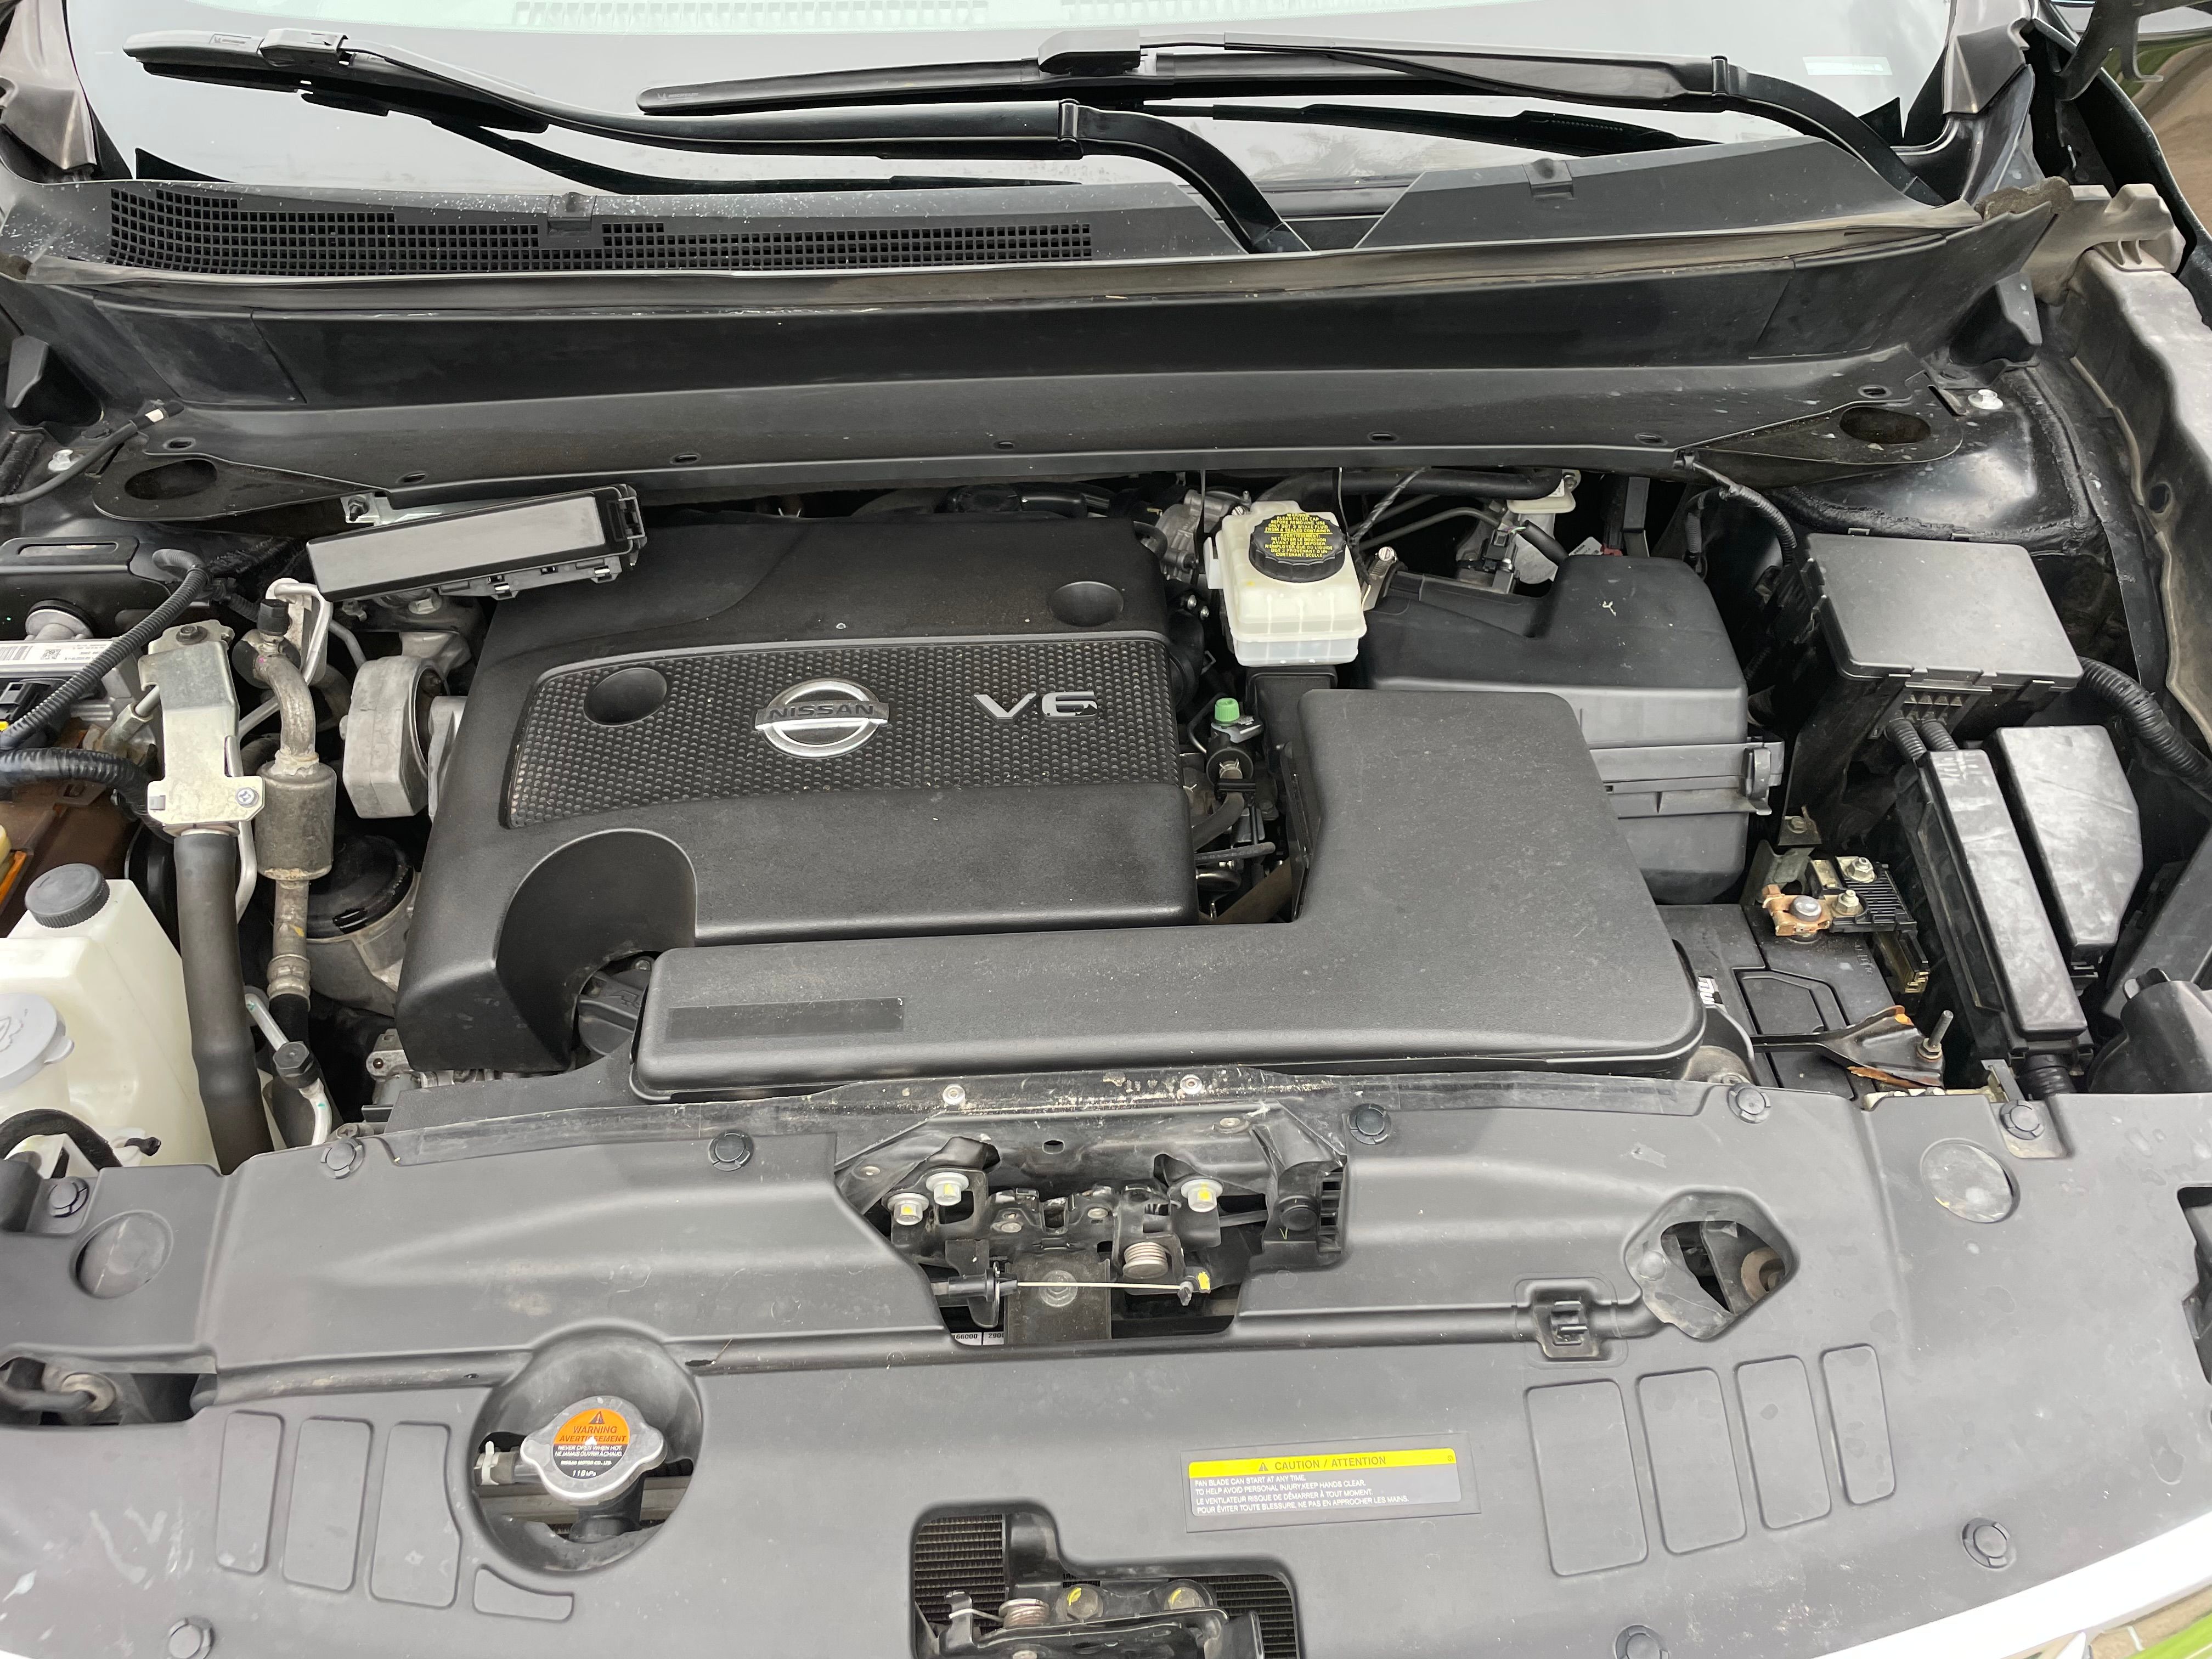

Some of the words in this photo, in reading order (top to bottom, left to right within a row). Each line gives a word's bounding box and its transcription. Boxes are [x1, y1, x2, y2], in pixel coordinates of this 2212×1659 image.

[768, 703, 874, 720] NISSAN
[972, 690, 1098, 722] V6
[1274, 1459, 1319, 1470] CAUTION
[1331, 1456, 1386, 1467] ATTENTION
[1205, 1496, 1246, 1504] VENTILATEUR
[1248, 1494, 1272, 1502] RISQUE
[1283, 1492, 1319, 1500] DÉMARRER
[1320, 1489, 1324, 1498] À
[1344, 1488, 1373, 1497] MOMENT.
[1244, 1485, 1279, 1493] PERSONAL
[1217, 1504, 1239, 1513] ÉVITER
[1261, 1502, 1297, 1510] BLESSURE,
[1333, 1497, 1373, 1506] APPROCHER
